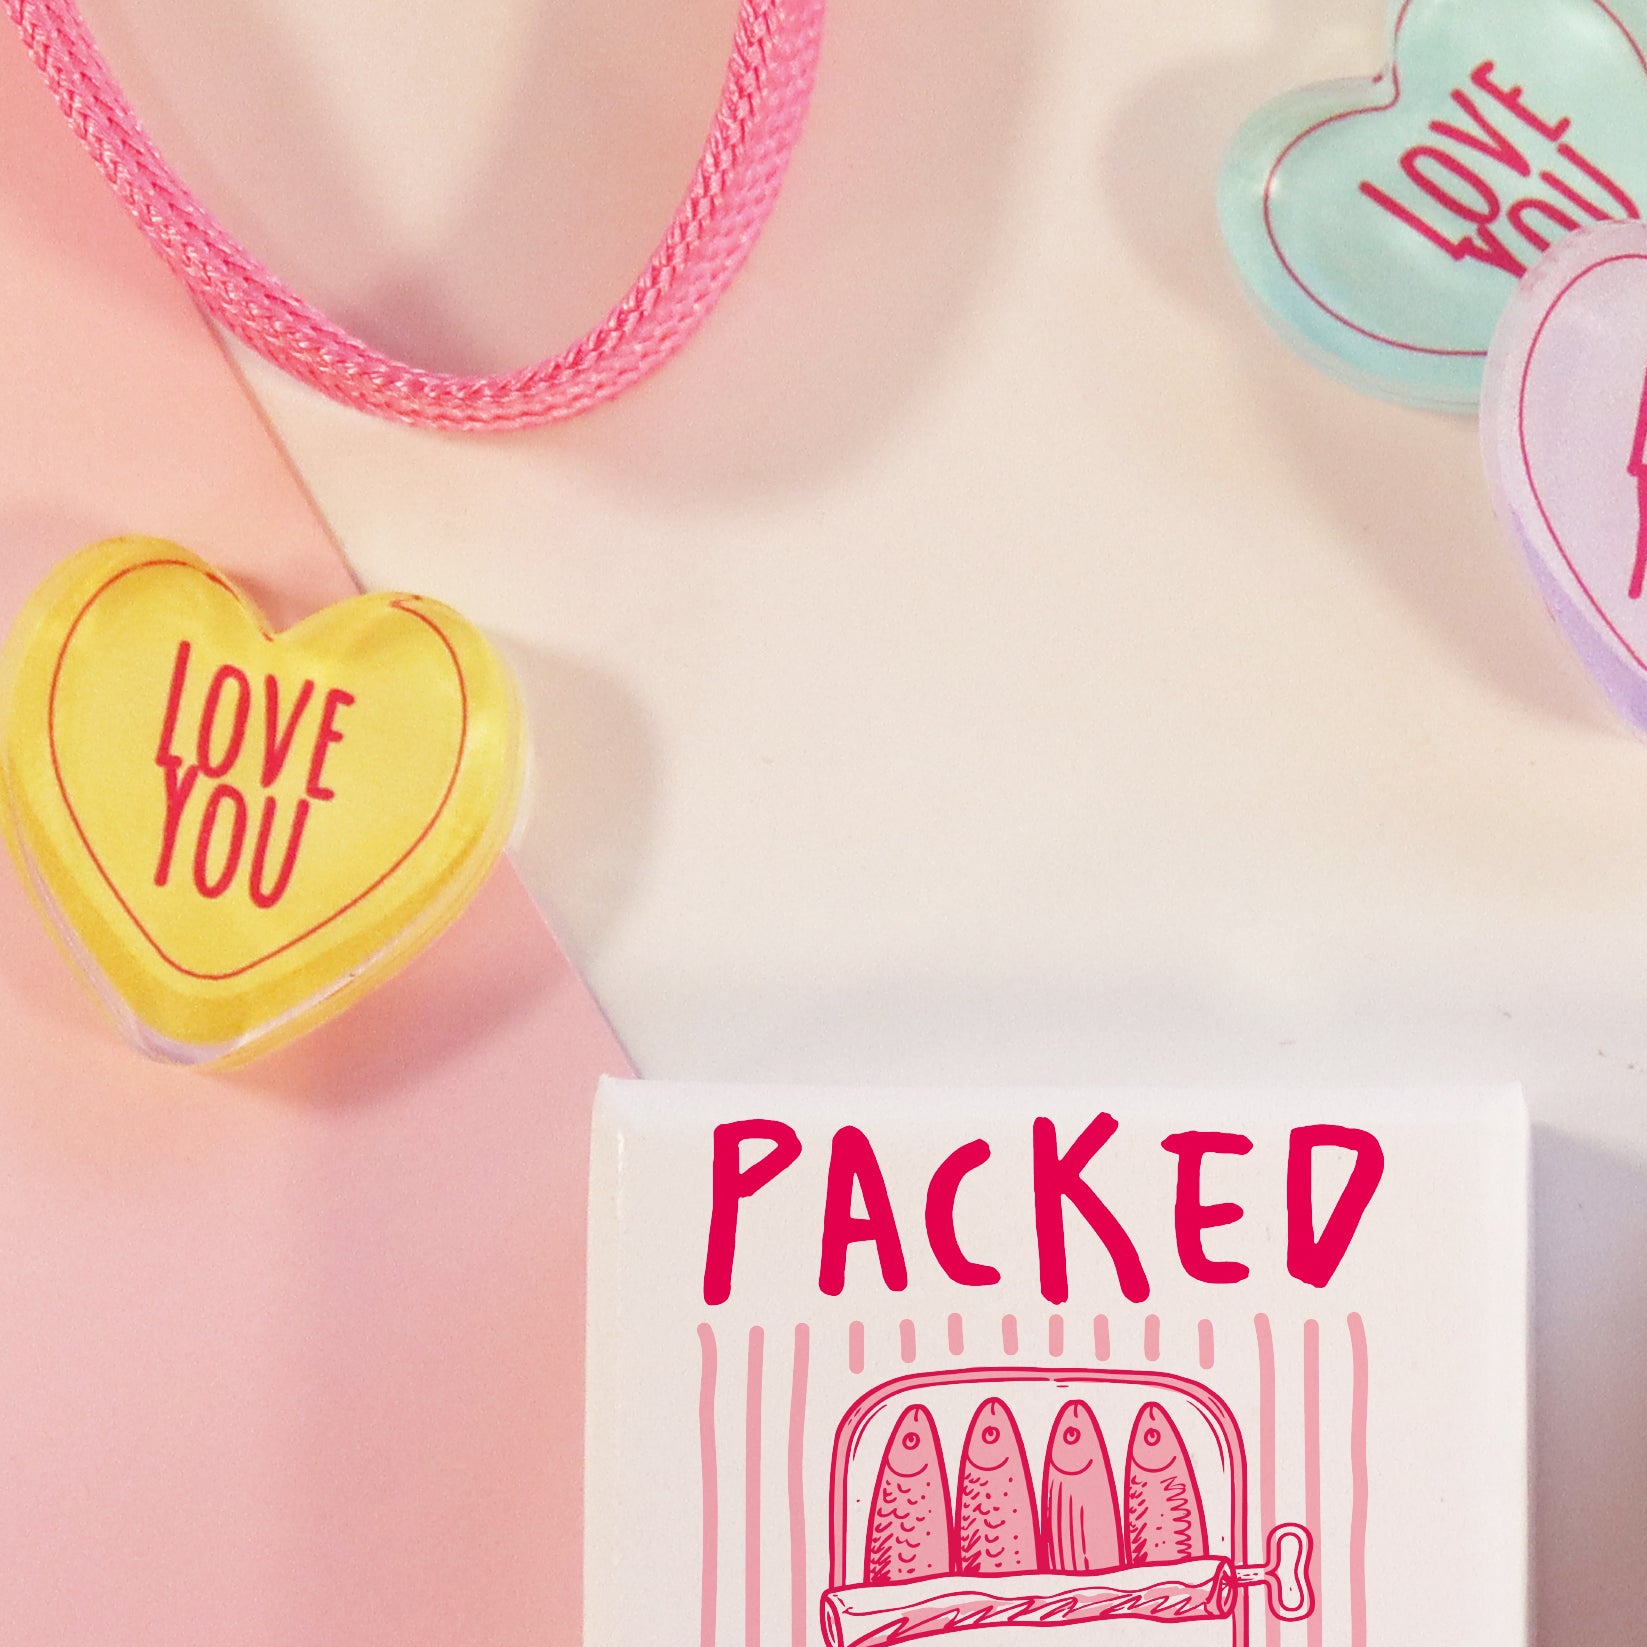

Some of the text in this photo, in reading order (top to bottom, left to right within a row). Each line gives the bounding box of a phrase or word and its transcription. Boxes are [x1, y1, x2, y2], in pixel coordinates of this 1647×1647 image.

[1358, 59, 1571, 262] LOVE
[155, 640, 355, 800] LOVE
[153, 763, 310, 909] YOU
[704, 1112, 1384, 1305] PACKED
